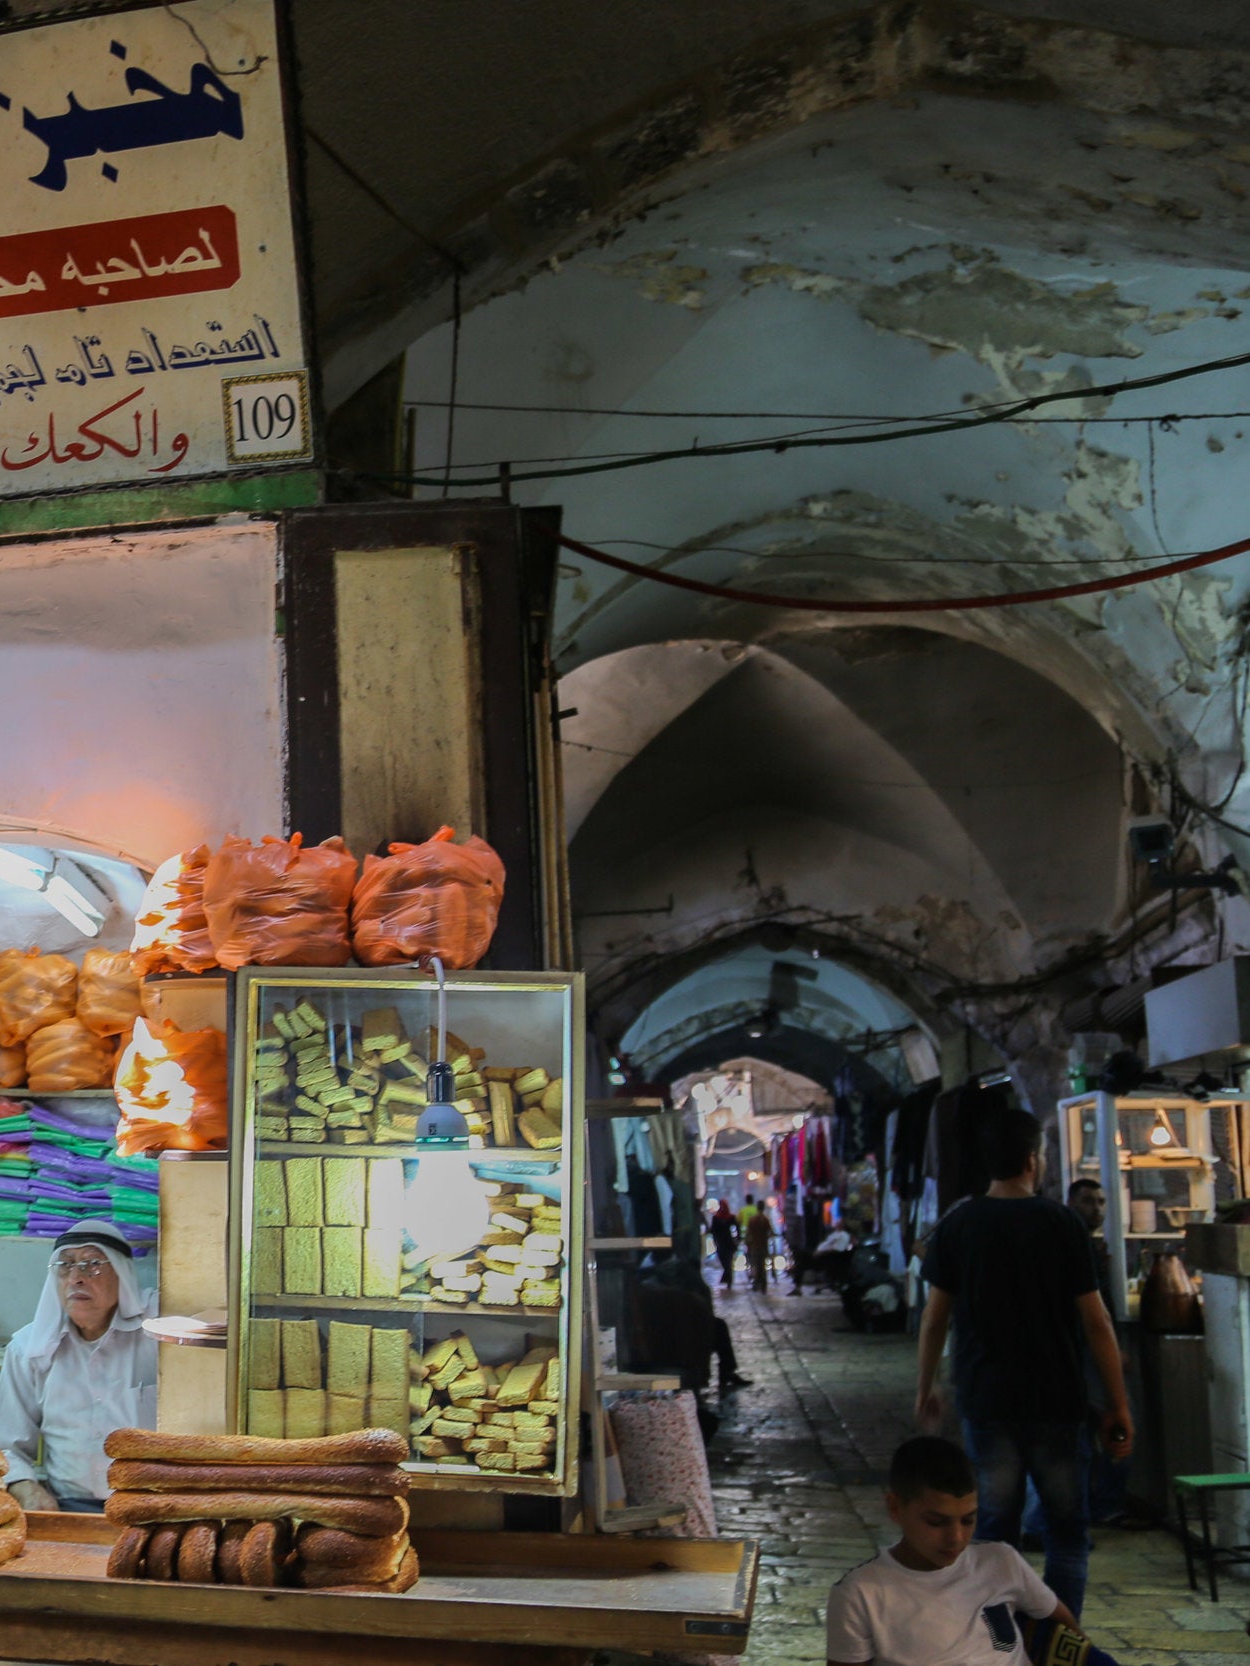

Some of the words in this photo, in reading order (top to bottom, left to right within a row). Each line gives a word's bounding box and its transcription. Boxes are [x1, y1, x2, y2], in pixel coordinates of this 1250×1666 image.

[60, 228, 223, 296] لصاحبه
[56, 335, 115, 386] تام
[126, 314, 280, 375] استعداد
[1, 387, 189, 472] والكعك
[232, 393, 297, 442] 109
